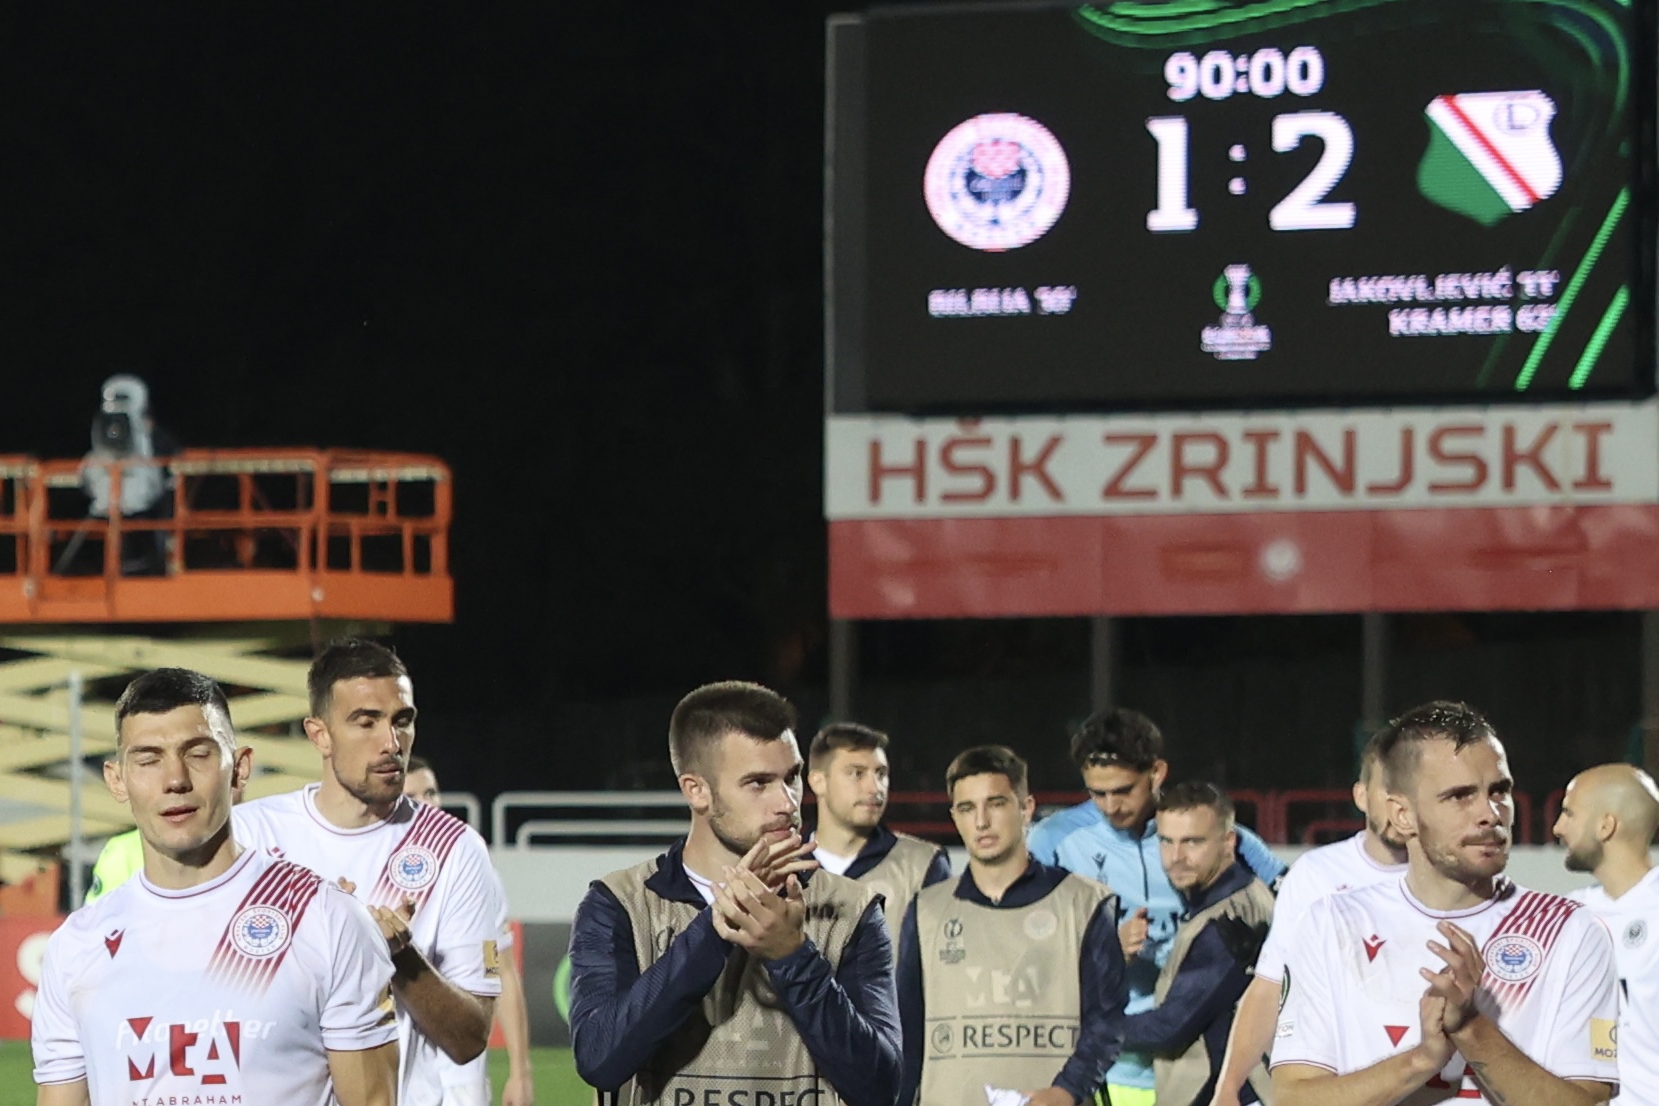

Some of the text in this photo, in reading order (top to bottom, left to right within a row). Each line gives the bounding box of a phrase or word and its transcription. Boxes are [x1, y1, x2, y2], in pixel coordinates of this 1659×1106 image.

[1164, 46, 1325, 101] 90:00
[1146, 115, 1199, 231] 1
[1269, 110, 1357, 231] 2
[1389, 305, 1513, 336] KRAMER
[868, 416, 1614, 505] HŠK ZRINJSKI
[963, 1024, 1080, 1049] RESPECT
[156, 1094, 242, 1106] ABRAHAM
